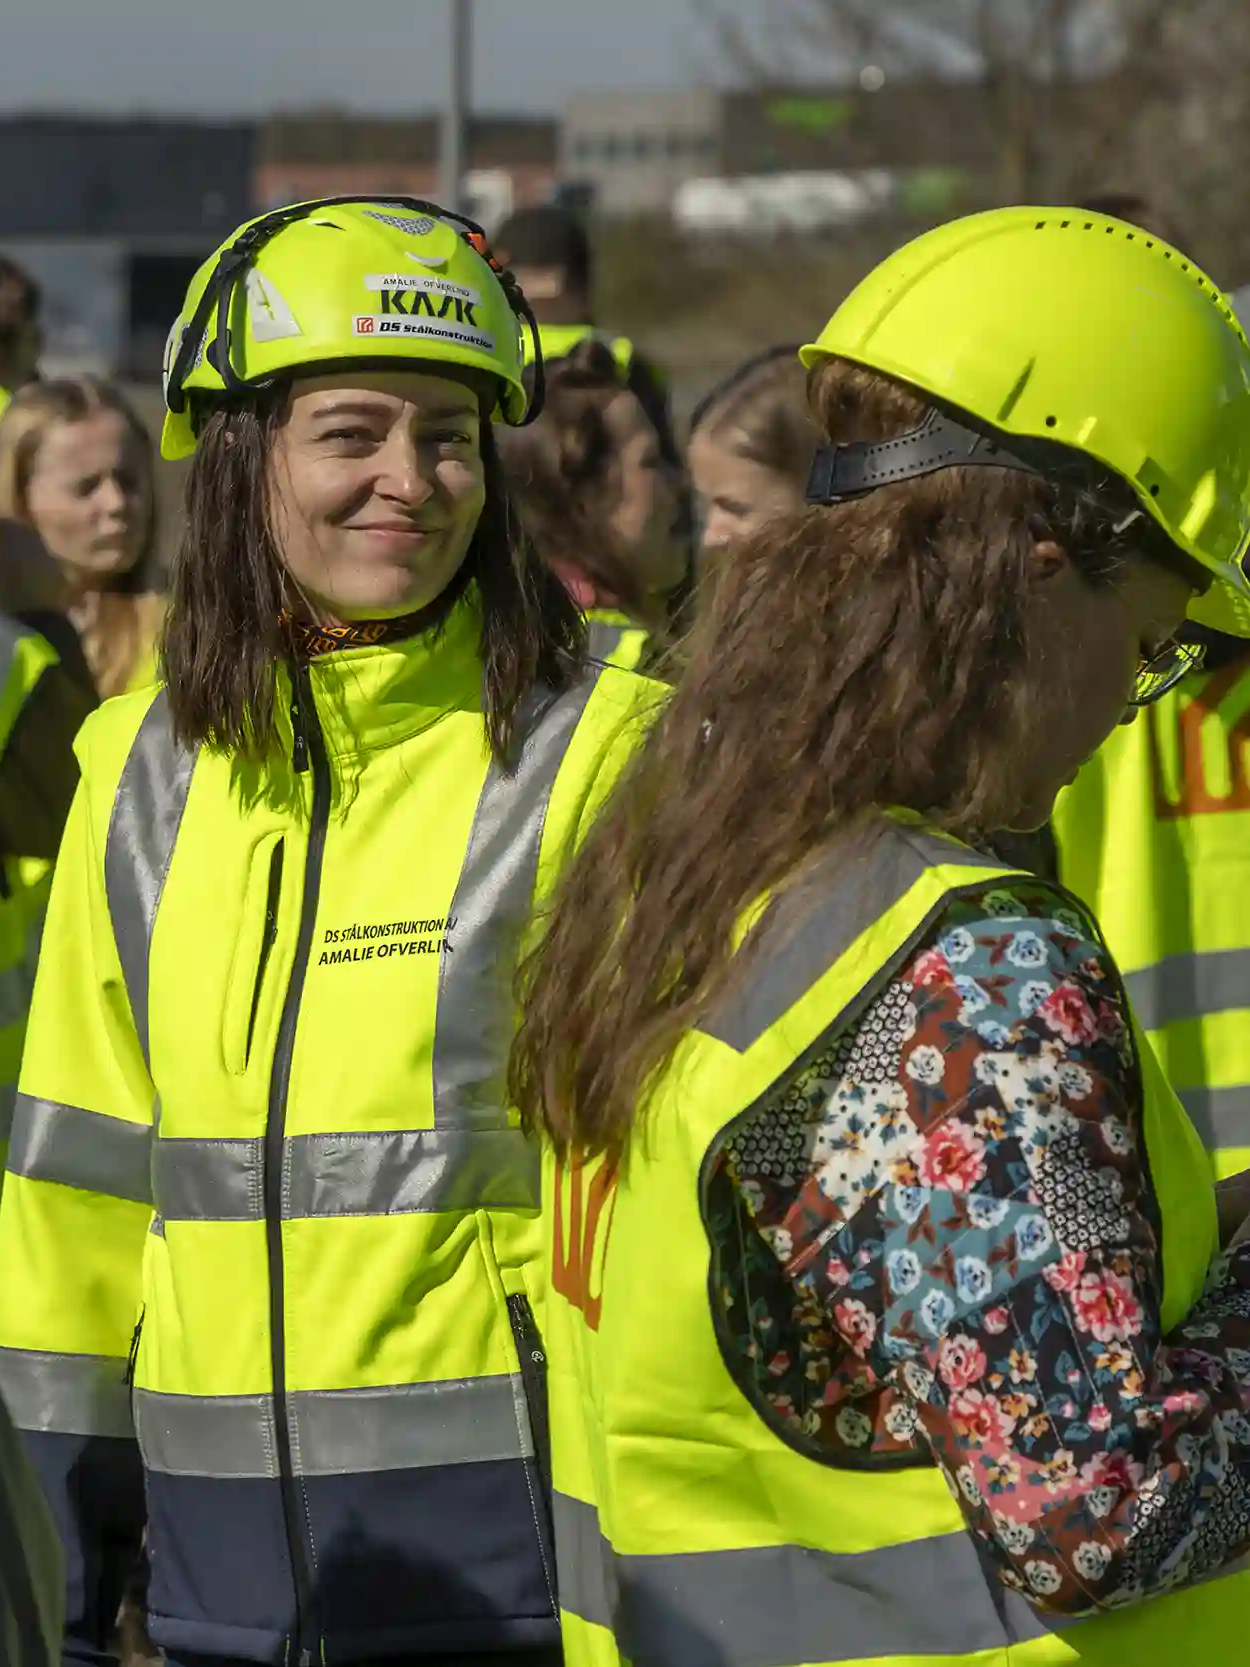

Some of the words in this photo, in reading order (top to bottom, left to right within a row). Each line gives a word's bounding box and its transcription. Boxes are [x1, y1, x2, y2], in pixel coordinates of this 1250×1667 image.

[383, 277, 417, 287] AMALIE
[379, 321, 401, 332] DS
[324, 930, 339, 944] DS
[341, 918, 445, 942] STÅLKONSTRUKTION
[318, 946, 374, 966] AMALIE
